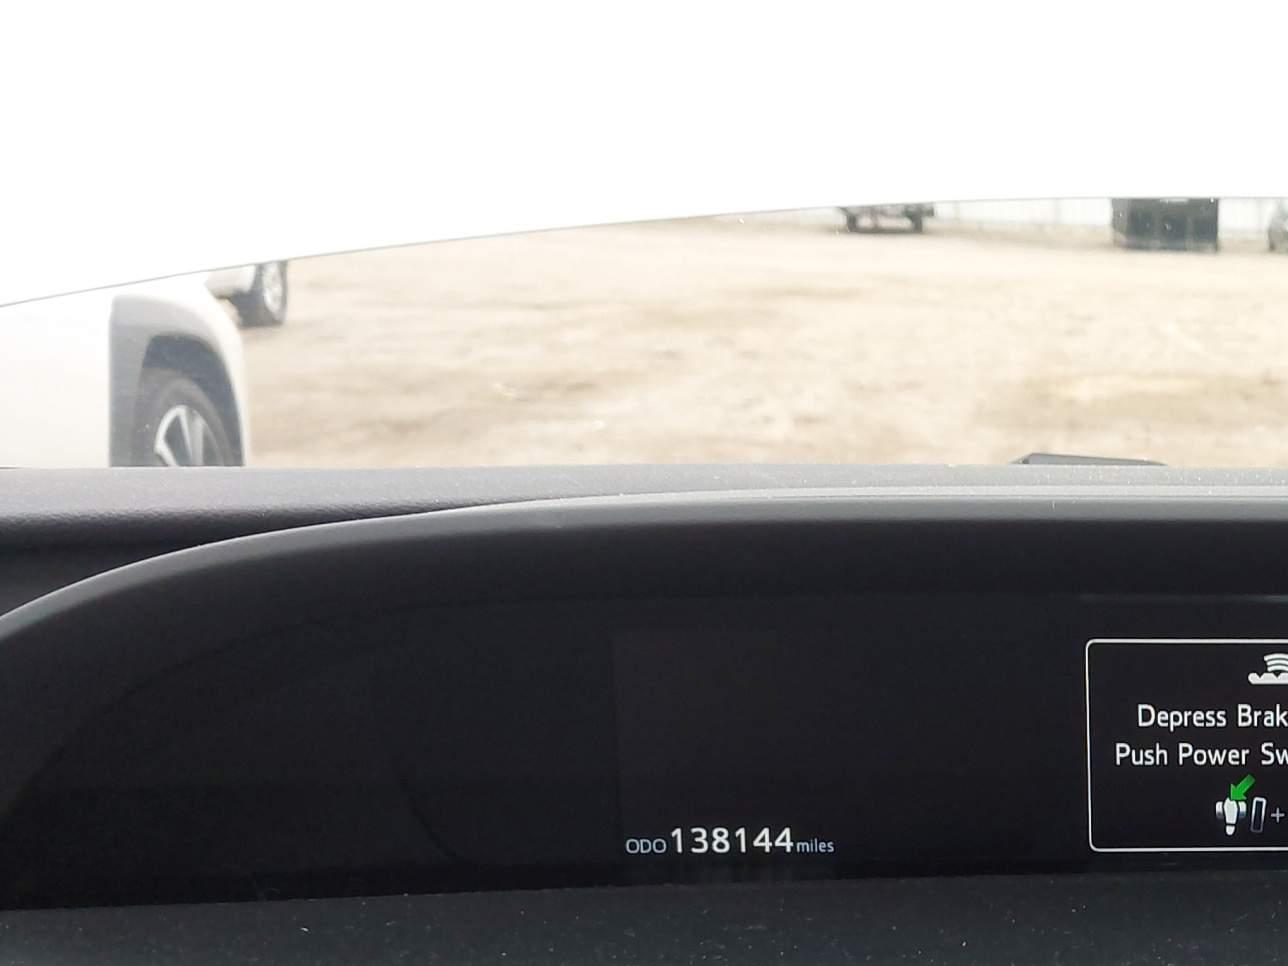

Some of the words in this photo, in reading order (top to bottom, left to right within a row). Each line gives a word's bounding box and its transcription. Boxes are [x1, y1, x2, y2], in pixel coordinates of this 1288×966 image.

[1137, 703, 1227, 732] Depress
[1115, 742, 1168, 766] Push
[1178, 742, 1250, 766] Power
[625, 838, 667, 854] ODO
[671, 827, 794, 854] 138144
[796, 837, 835, 854] miles
